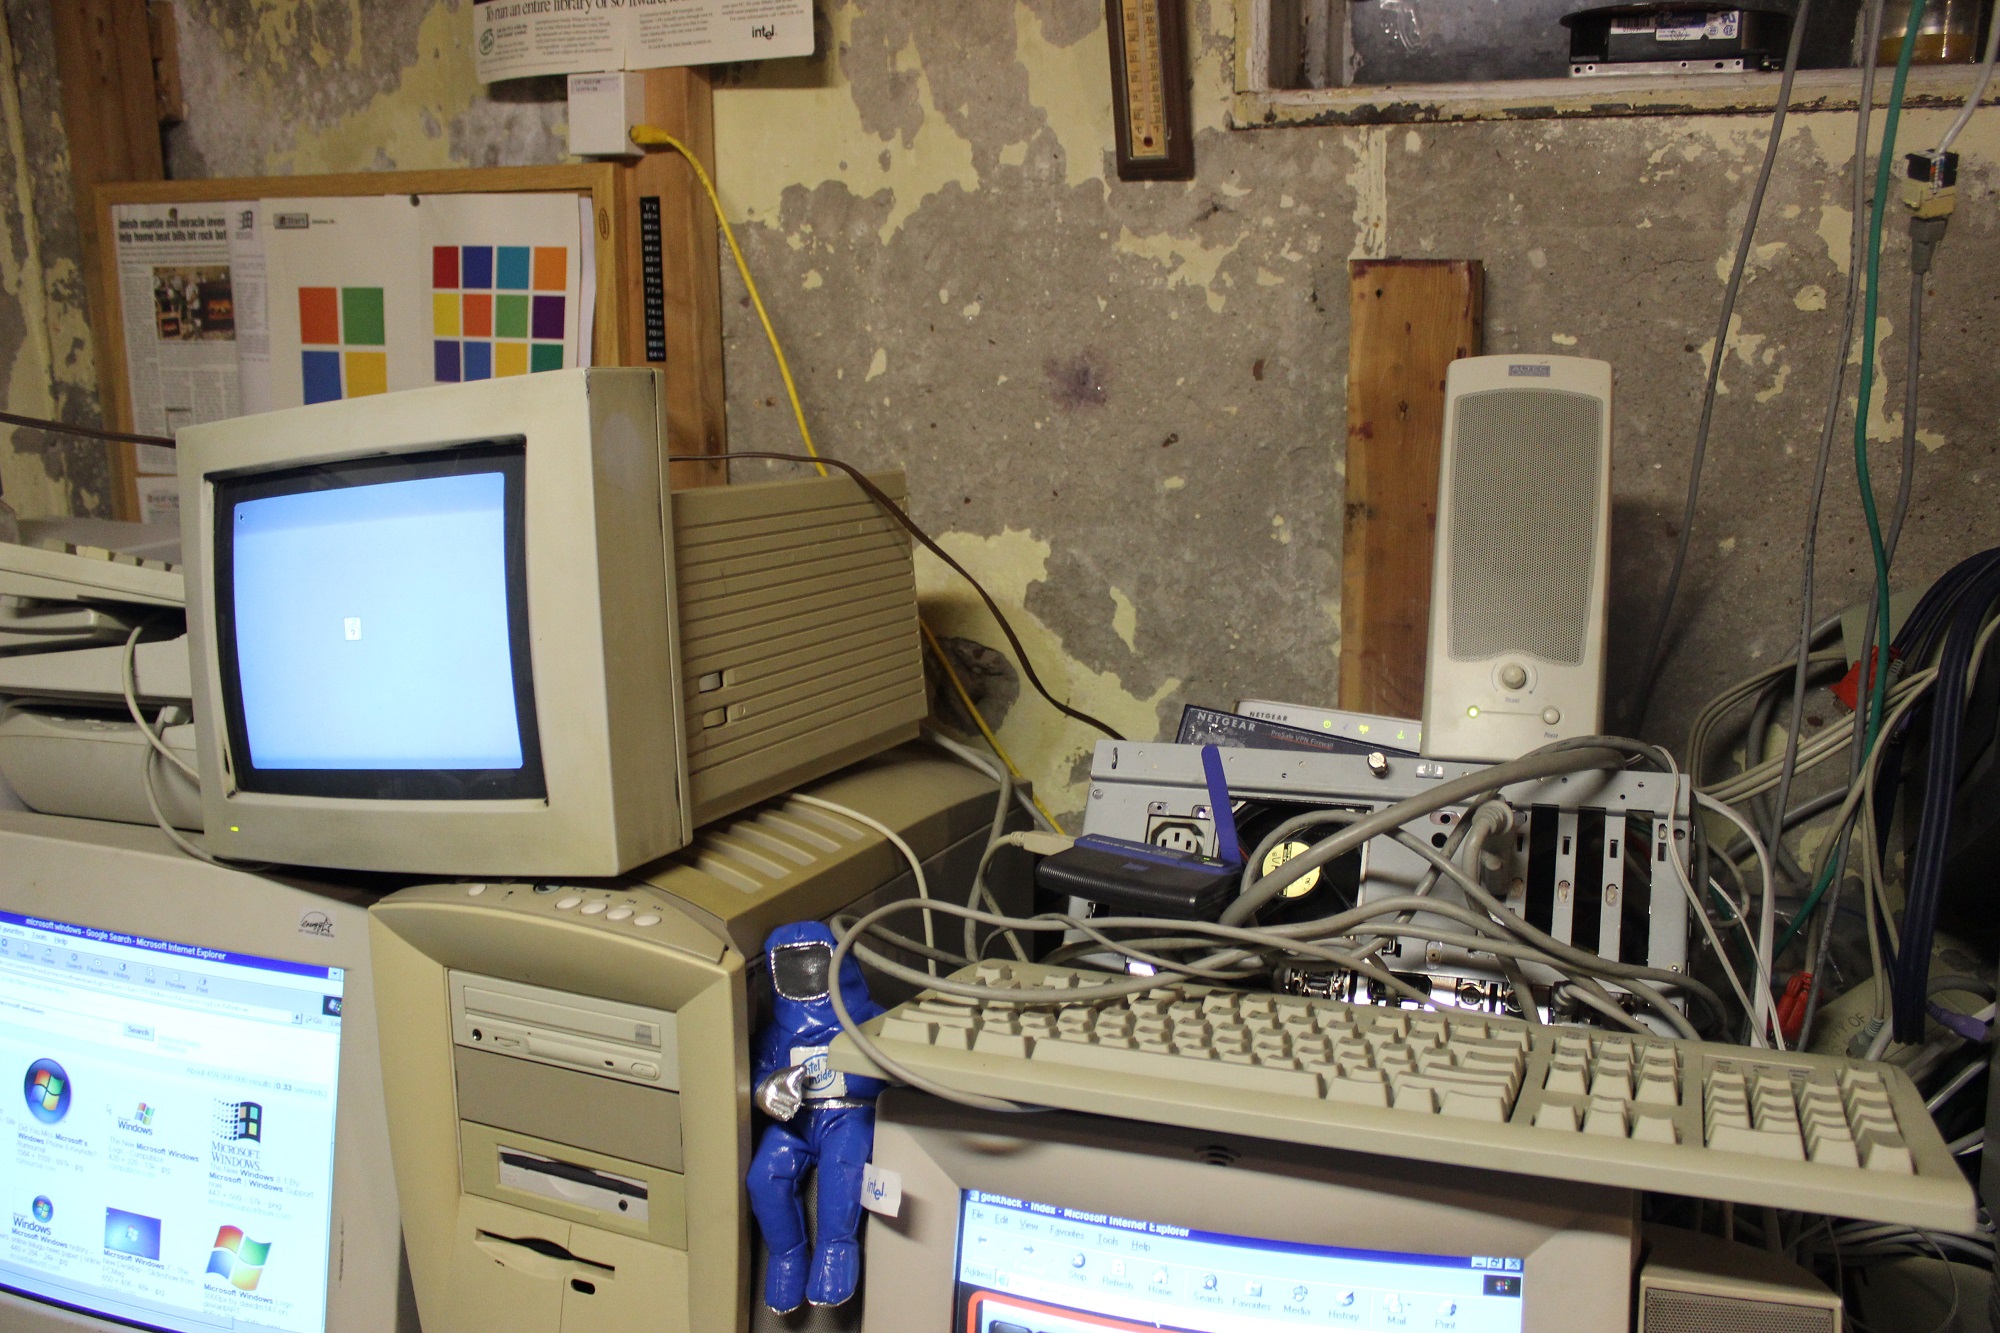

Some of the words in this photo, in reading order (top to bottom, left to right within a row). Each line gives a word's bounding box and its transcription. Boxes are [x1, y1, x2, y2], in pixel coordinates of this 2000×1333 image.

[486, 5, 495, 22] To
[495, 6, 509, 20] run
[509, 5, 521, 17] an
[521, 0, 551, 15] entire
[553, 0, 591, 15] library
[752, 24, 776, 40] intel
[1196, 712, 1256, 732] NETGEAR
[1249, 711, 1288, 722] NETGEAR
[1271, 729, 1294, 740] ProSafe
[1295, 734, 1310, 744] VPN
[1311, 737, 1334, 749] Firewall
[25, 917, 54, 930] microsoft
[54, 923, 82, 935] windows
[86, 928, 108, 941] Google
[109, 932, 132, 944] Search
[136, 937, 168, 950] Microsoft
[168, 943, 196, 956] Internet
[196, 948, 226, 961] Explorer
[31, 931, 48, 942] Tools
[54, 936, 68, 946] Help
[41, 956, 55, 965] Home
[66, 961, 83, 971] Search
[87, 965, 109, 976] Favorites
[165, 980, 187, 990] Preview
[22, 1005, 45, 1015] windows
[1848, 1011, 1865, 1027] OF
[127, 1026, 150, 1038] Search
[186, 1066, 205, 1077] About
[249, 1077, 272, 1088] results
[805, 1059, 820, 1075] ntel
[117, 1119, 154, 1136] Windows
[18, 1132, 45, 1145] Windows
[55, 1133, 88, 1147] Microsoft's
[109, 1136, 120, 1145] The
[136, 1142, 166, 1156] Microsoft
[168, 1149, 199, 1163] Windows
[210, 1163, 222, 1172] The
[223, 1166, 238, 1175] New
[240, 1169, 274, 1182] Windows
[209, 1172, 242, 1184] Microsoft
[249, 1180, 283, 1193] Windows
[285, 1187, 315, 1199] Support
[867, 1178, 885, 1200] intel
[268, 1201, 282, 1211] png
[981, 1193, 1022, 1209] geekhack
[1030, 1201, 1056, 1216] Index
[1064, 1208, 1107, 1224] Microsoft
[1109, 1216, 1147, 1232] Internet
[1149, 1222, 1189, 1238] Explorer
[13, 1216, 52, 1236] Windows
[971, 1209, 984, 1220] File
[994, 1214, 1009, 1225] Edit
[1019, 1219, 1039, 1231] View
[1050, 1225, 1084, 1240] Favorites
[1097, 1233, 1119, 1246] Tools
[1131, 1240, 1151, 1252] Help
[11, 1228, 39, 1240] Microsoft
[40, 1235, 68, 1249] Windows
[69, 1242, 88, 1255] history
[11, 1236, 28, 1246] online
[46, 1246, 61, 1254] news
[61, 1249, 79, 1261] paper
[84, 1254, 101, 1265] online
[102, 1257, 116, 1266] New
[116, 1261, 142, 1273] Desktop
[147, 1269, 179, 1282] Slideshow
[180, 1275, 196, 1286] from
[102, 1266, 125, 1278] PCMag
[103, 1249, 133, 1262] Microsoft
[134, 1256, 165, 1270] Windows
[177, 1266, 190, 1276] The
[964, 1267, 993, 1281] Address
[203, 1283, 237, 1297] Microsoft
[239, 1290, 274, 1304] Windows
[275, 1297, 293, 1308] Logo
[1068, 1270, 1087, 1282] Stop
[1102, 1275, 1134, 1290] Refresh
[1148, 1284, 1173, 1297] Home
[1193, 1291, 1224, 1305] Search
[1232, 1299, 1271, 1312] Favorites
[1283, 1303, 1310, 1317] Media
[1328, 1309, 1360, 1323] History
[1387, 1314, 1407, 1326] Mail
[1434, 1319, 1456, 1331] Print
[228, 1296, 238, 1305] by
[278, 1308, 288, 1316] on
